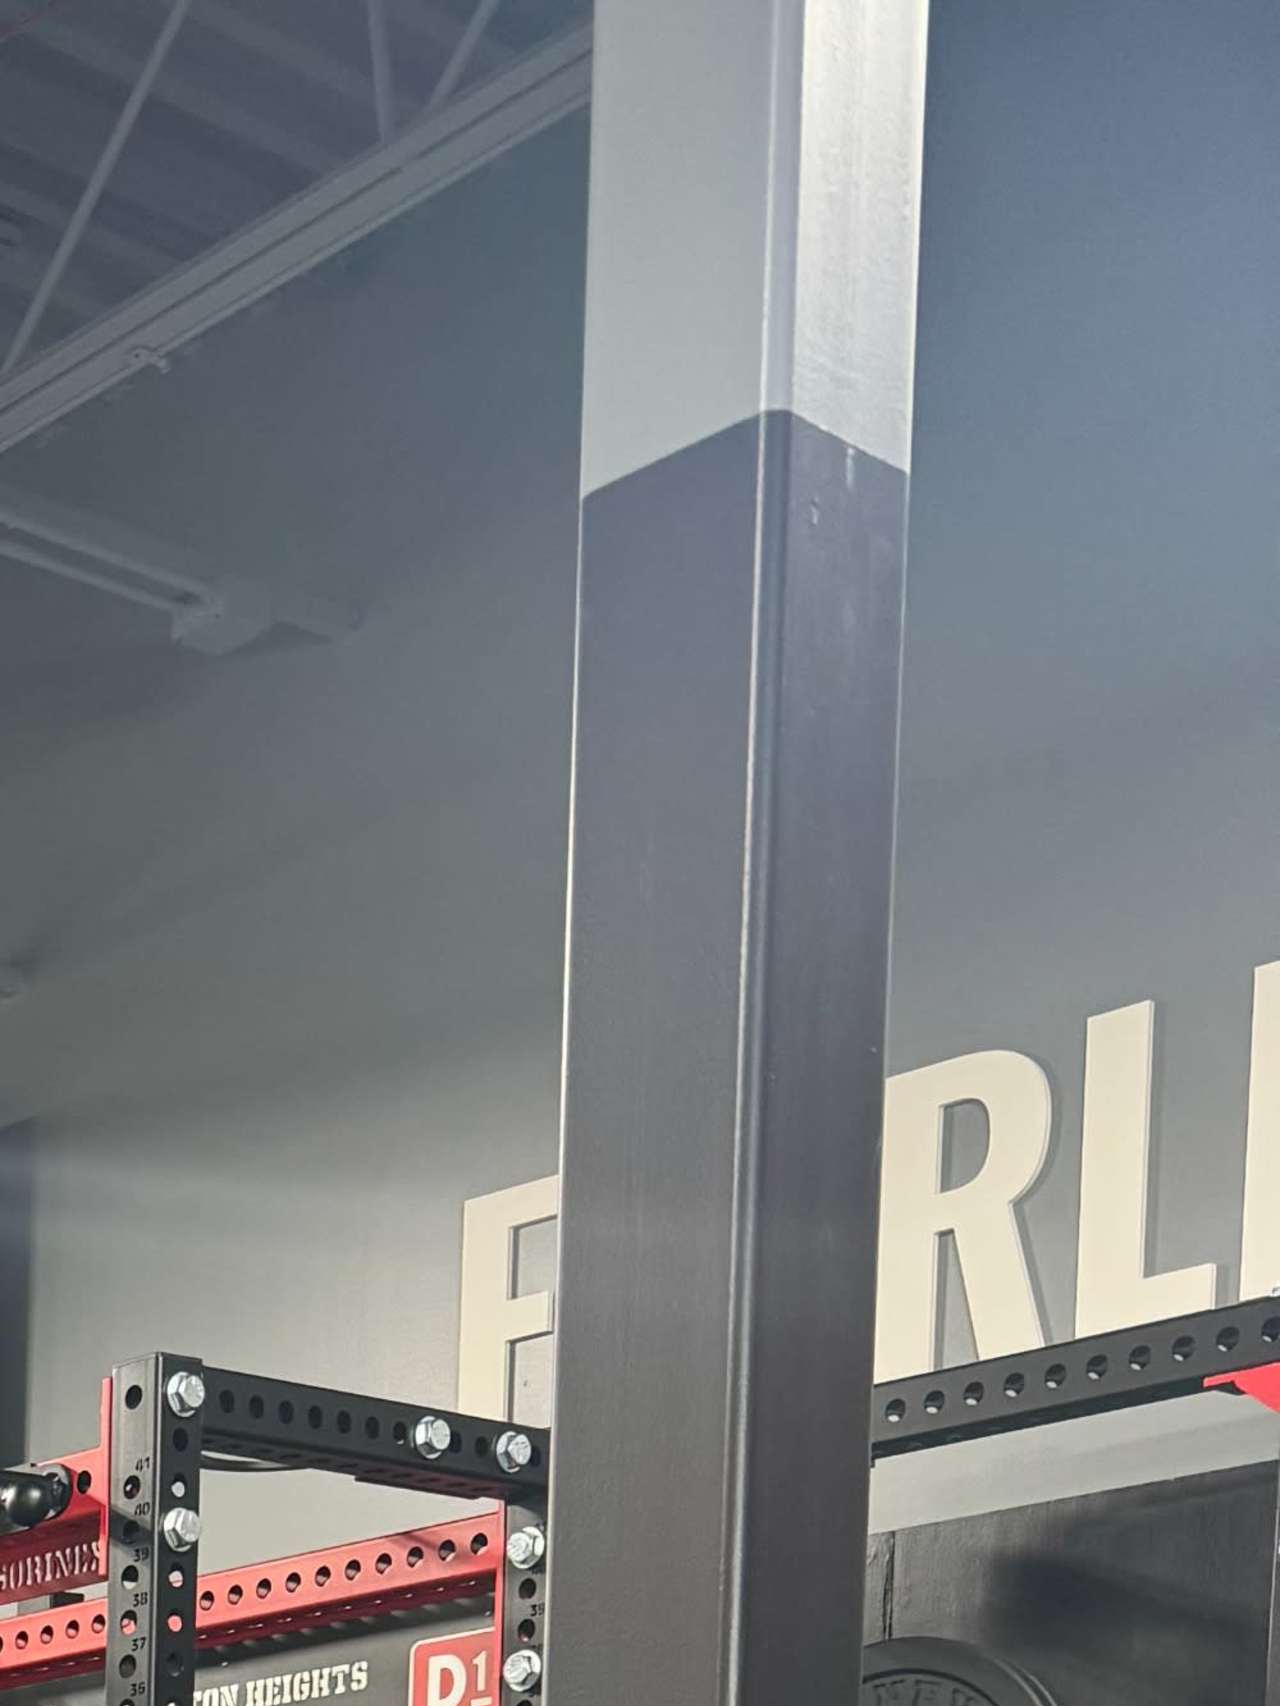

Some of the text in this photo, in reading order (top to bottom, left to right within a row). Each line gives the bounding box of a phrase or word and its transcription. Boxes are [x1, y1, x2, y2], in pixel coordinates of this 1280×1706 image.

[131, 1546, 151, 1562] 39
[133, 1592, 150, 1607] 38
[132, 1637, 146, 1651] 37
[131, 1682, 145, 1697] 36
